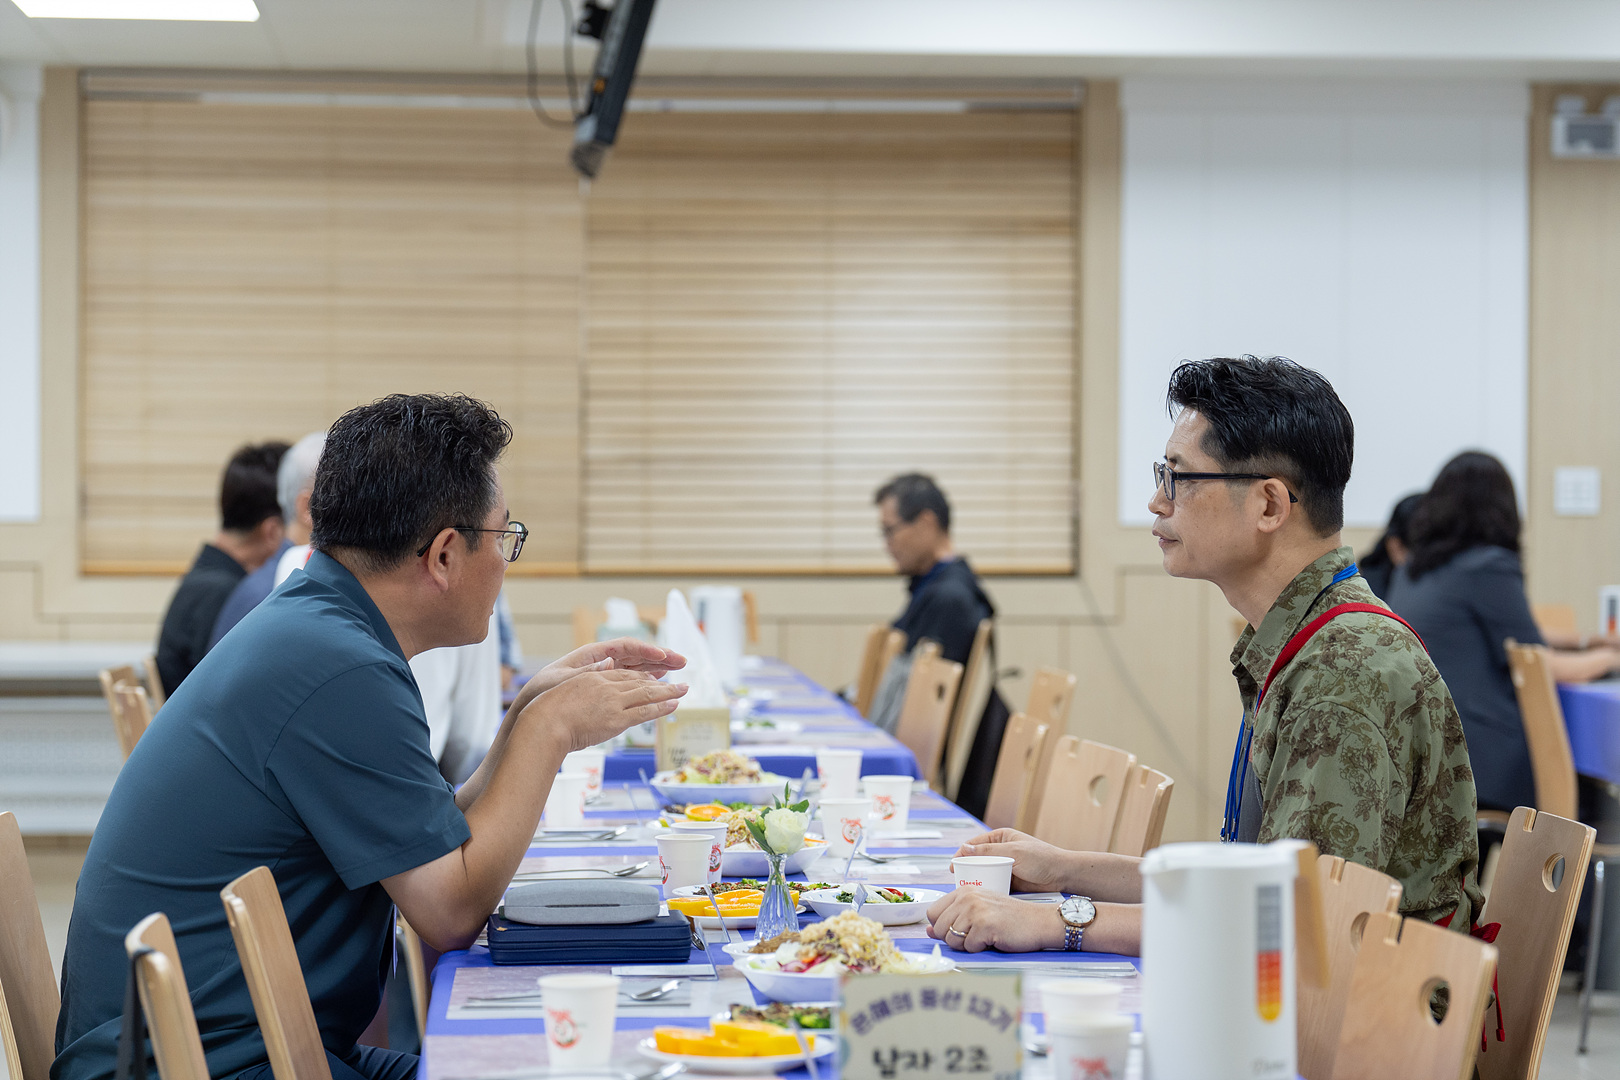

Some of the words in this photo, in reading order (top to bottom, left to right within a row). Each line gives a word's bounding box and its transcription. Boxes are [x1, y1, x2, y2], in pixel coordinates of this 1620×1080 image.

[852, 990, 912, 1035] 은혜의
[873, 1046, 932, 1078] 남자
[946, 1045, 991, 1073] 2조
